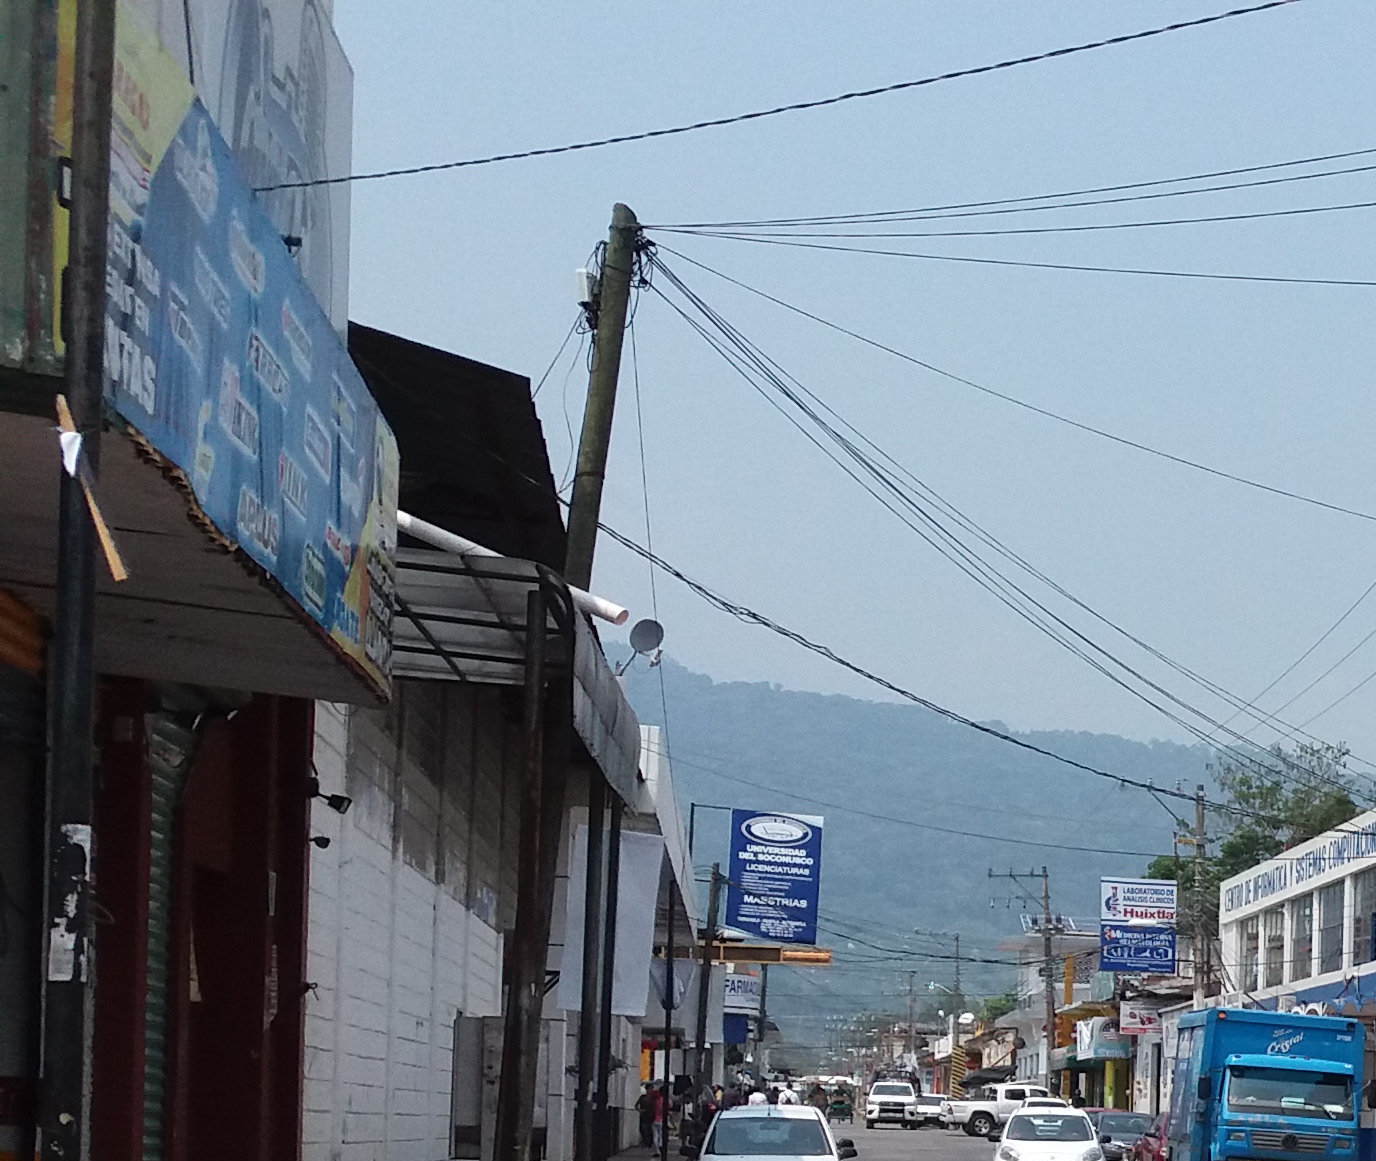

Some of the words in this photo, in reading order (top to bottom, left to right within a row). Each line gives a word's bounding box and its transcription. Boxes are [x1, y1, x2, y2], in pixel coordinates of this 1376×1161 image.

[747, 844, 806, 856] UNIVERSIDAD
[739, 852, 756, 860] DEL
[758, 854, 813, 865] SOCONUSCO
[746, 863, 809, 875] LICENCIATURAS
[1224, 886, 1243, 912] CENTRO
[1244, 879, 1251, 904] DE
[1252, 862, 1288, 901] INFORMATICA
[1288, 861, 1294, 888] Y
[1294, 845, 1327, 885] SISTEMAS
[1123, 887, 1164, 896] LABORATORIO
[1123, 908, 1174, 920] Huixtla
[1267, 1031, 1304, 1054] Cristal
